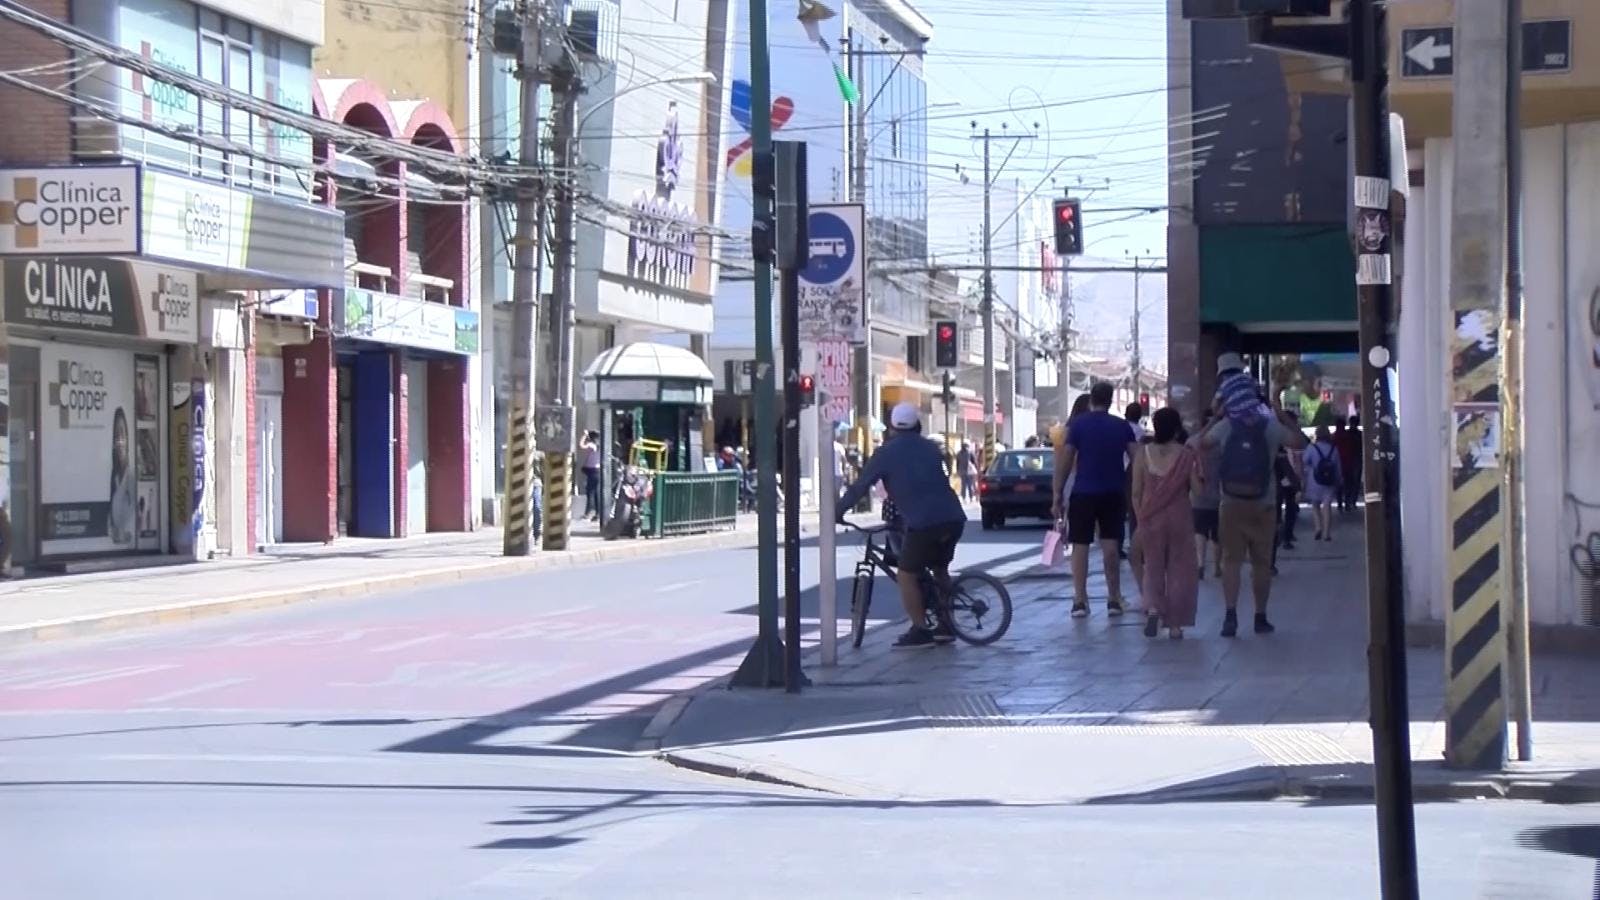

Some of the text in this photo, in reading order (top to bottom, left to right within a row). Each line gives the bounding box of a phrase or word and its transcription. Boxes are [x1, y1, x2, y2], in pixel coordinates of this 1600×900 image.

[40, 180, 121, 203] Clínica
[15, 199, 130, 235] Copper
[184, 208, 223, 246] Copper
[60, 383, 108, 419] Copper
